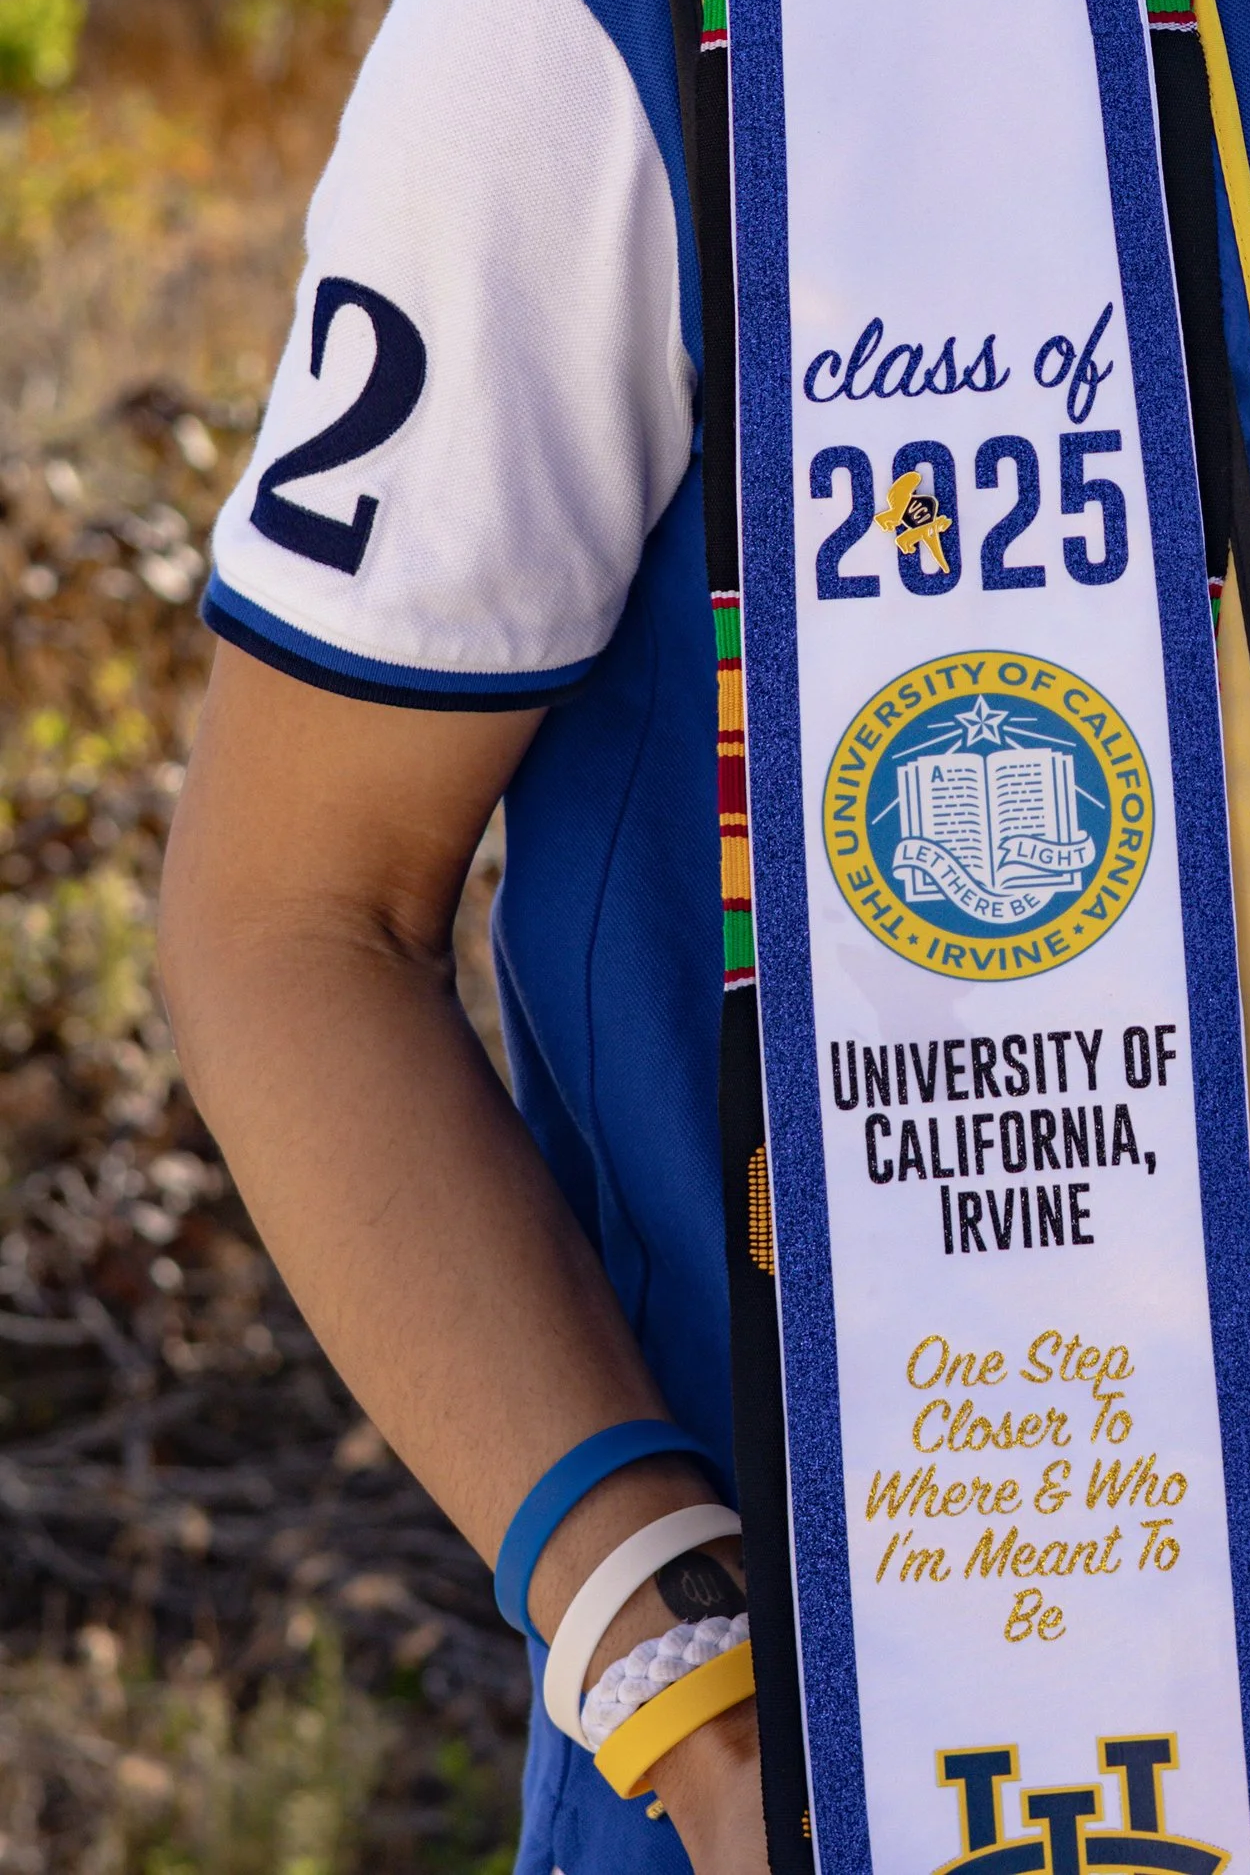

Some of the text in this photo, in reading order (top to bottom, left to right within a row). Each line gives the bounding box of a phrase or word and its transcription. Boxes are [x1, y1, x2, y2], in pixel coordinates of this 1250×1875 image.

[804, 302, 1114, 424] class of
[250, 276, 427, 577] 2
[809, 429, 1129, 601] 2025
[908, 500, 931, 524] UCI
[833, 661, 1145, 940] THE UNIVERSITY OF CALIFORNIA
[902, 841, 1087, 918] LET THERE BE LIGHT
[926, 930, 1071, 971] IRVINE
[830, 1024, 1176, 1110] UNIVERSITY OF
[940, 1182, 1094, 1255] IRVINE
[905, 1329, 1135, 1398] One Step
[912, 1391, 1134, 1453] Closer To
[865, 1452, 1188, 1522] Where & Who
[875, 1518, 1181, 1584] I'm Meant To
[1003, 1588, 1066, 1643] Be
